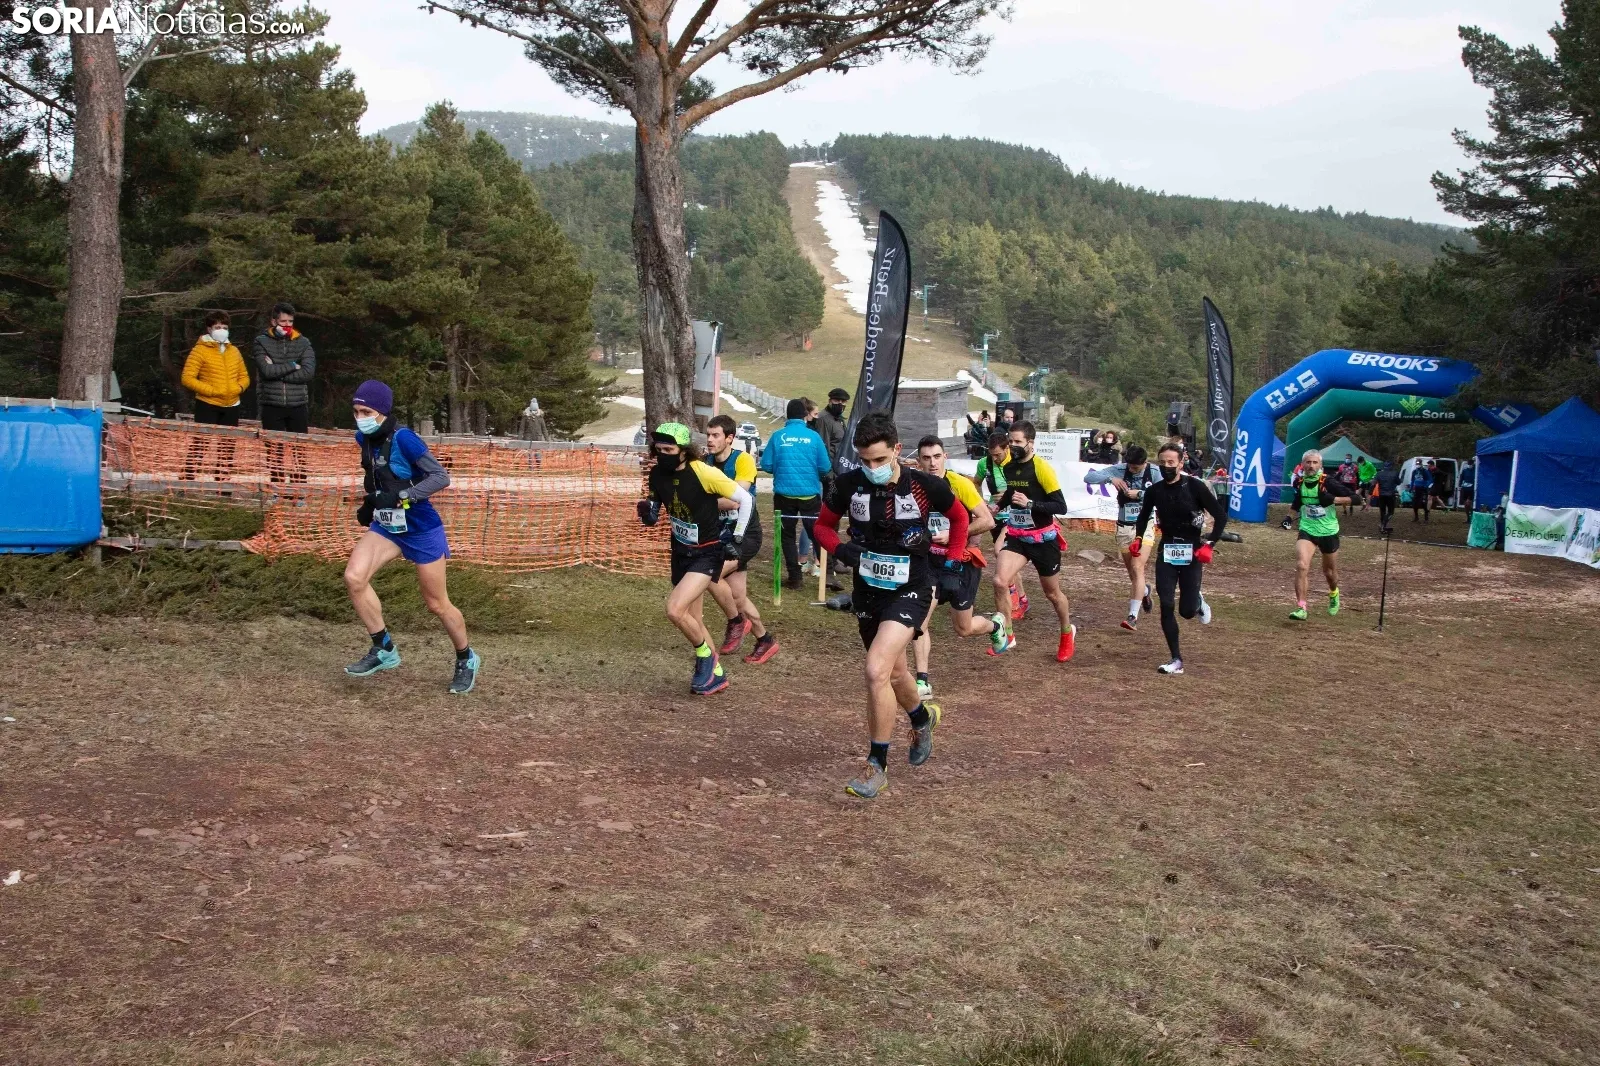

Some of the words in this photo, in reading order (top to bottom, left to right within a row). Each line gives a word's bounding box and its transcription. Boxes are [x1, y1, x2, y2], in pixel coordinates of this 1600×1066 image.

[1347, 352, 1440, 372] BROOKS
[1374, 408, 1401, 419] Caja
[1422, 409, 1455, 419] Soria
[1229, 428, 1249, 512] BROOKS
[380, 511, 393, 522] 067
[1171, 549, 1185, 557] 064
[873, 562, 895, 577] 063
